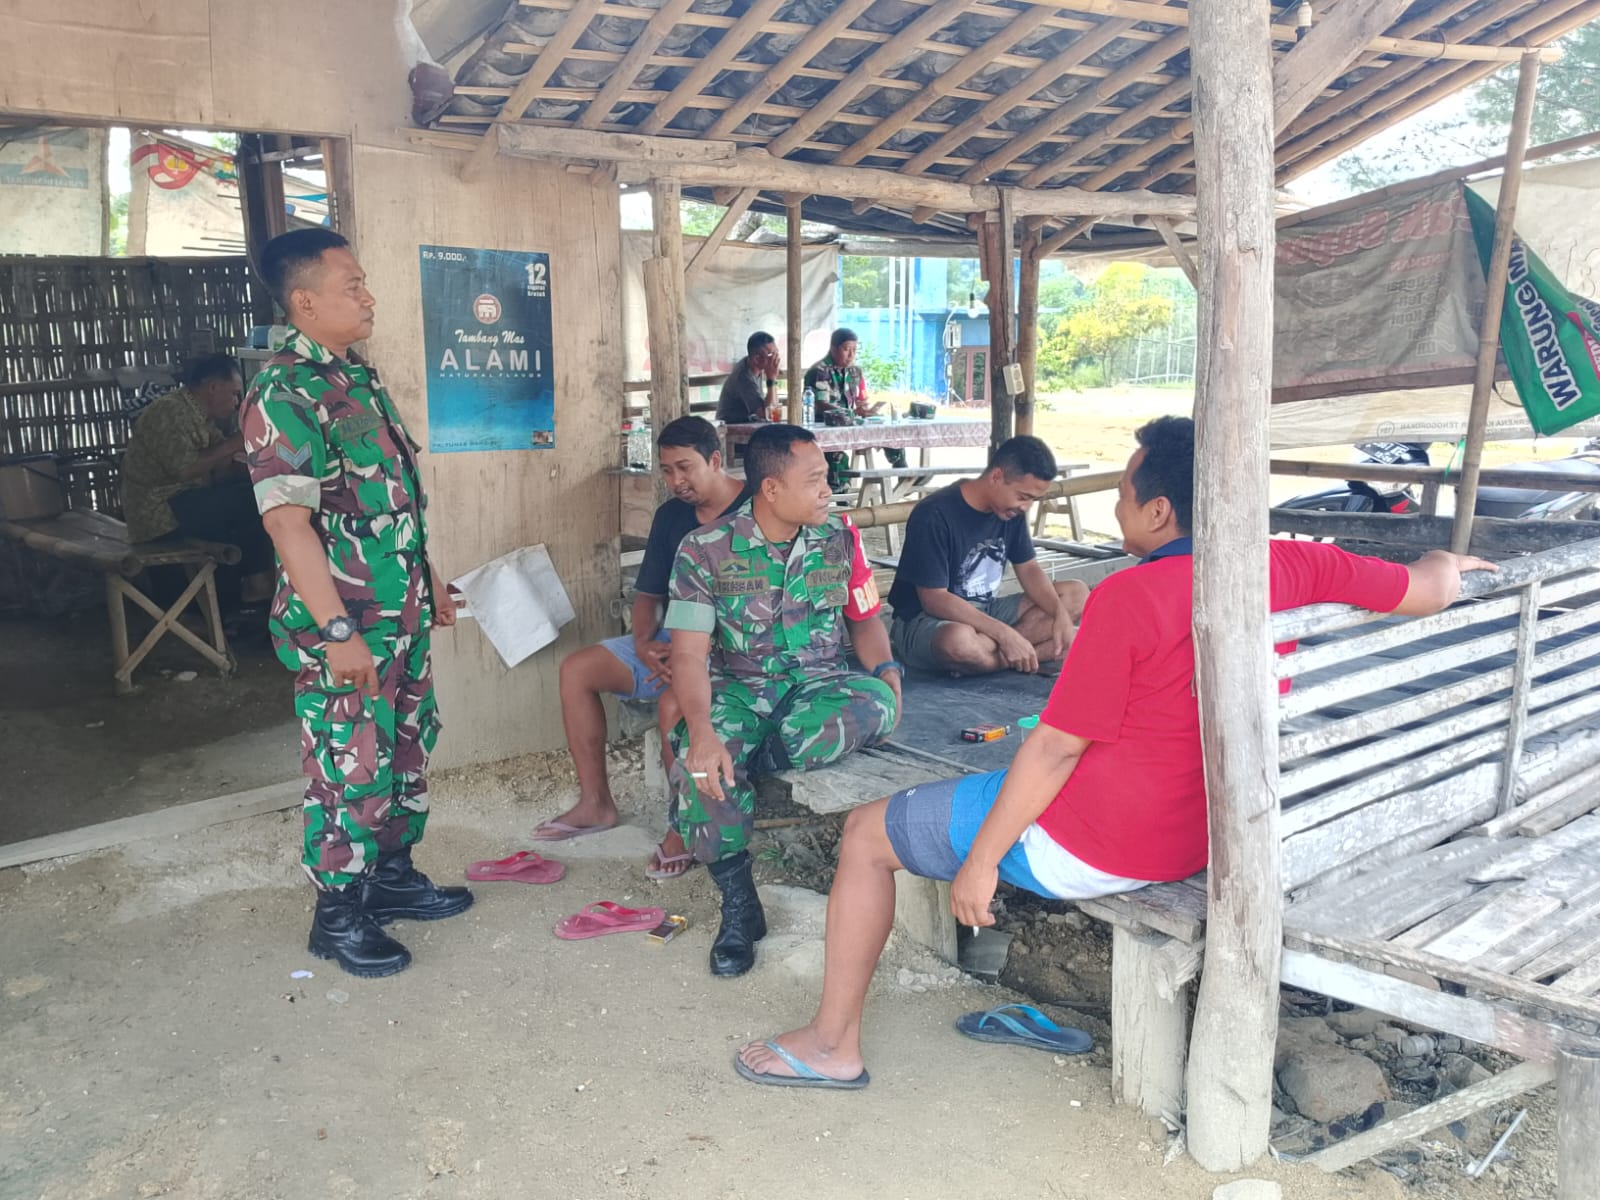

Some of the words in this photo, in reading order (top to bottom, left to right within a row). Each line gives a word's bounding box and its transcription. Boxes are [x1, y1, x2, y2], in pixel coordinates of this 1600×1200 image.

[525, 263, 546, 285] 12
[455, 329, 499, 346] Tambang
[502, 330, 525, 344] Mas
[1515, 281, 1581, 411] WARUNG
[440, 349, 541, 371] ALAMI
